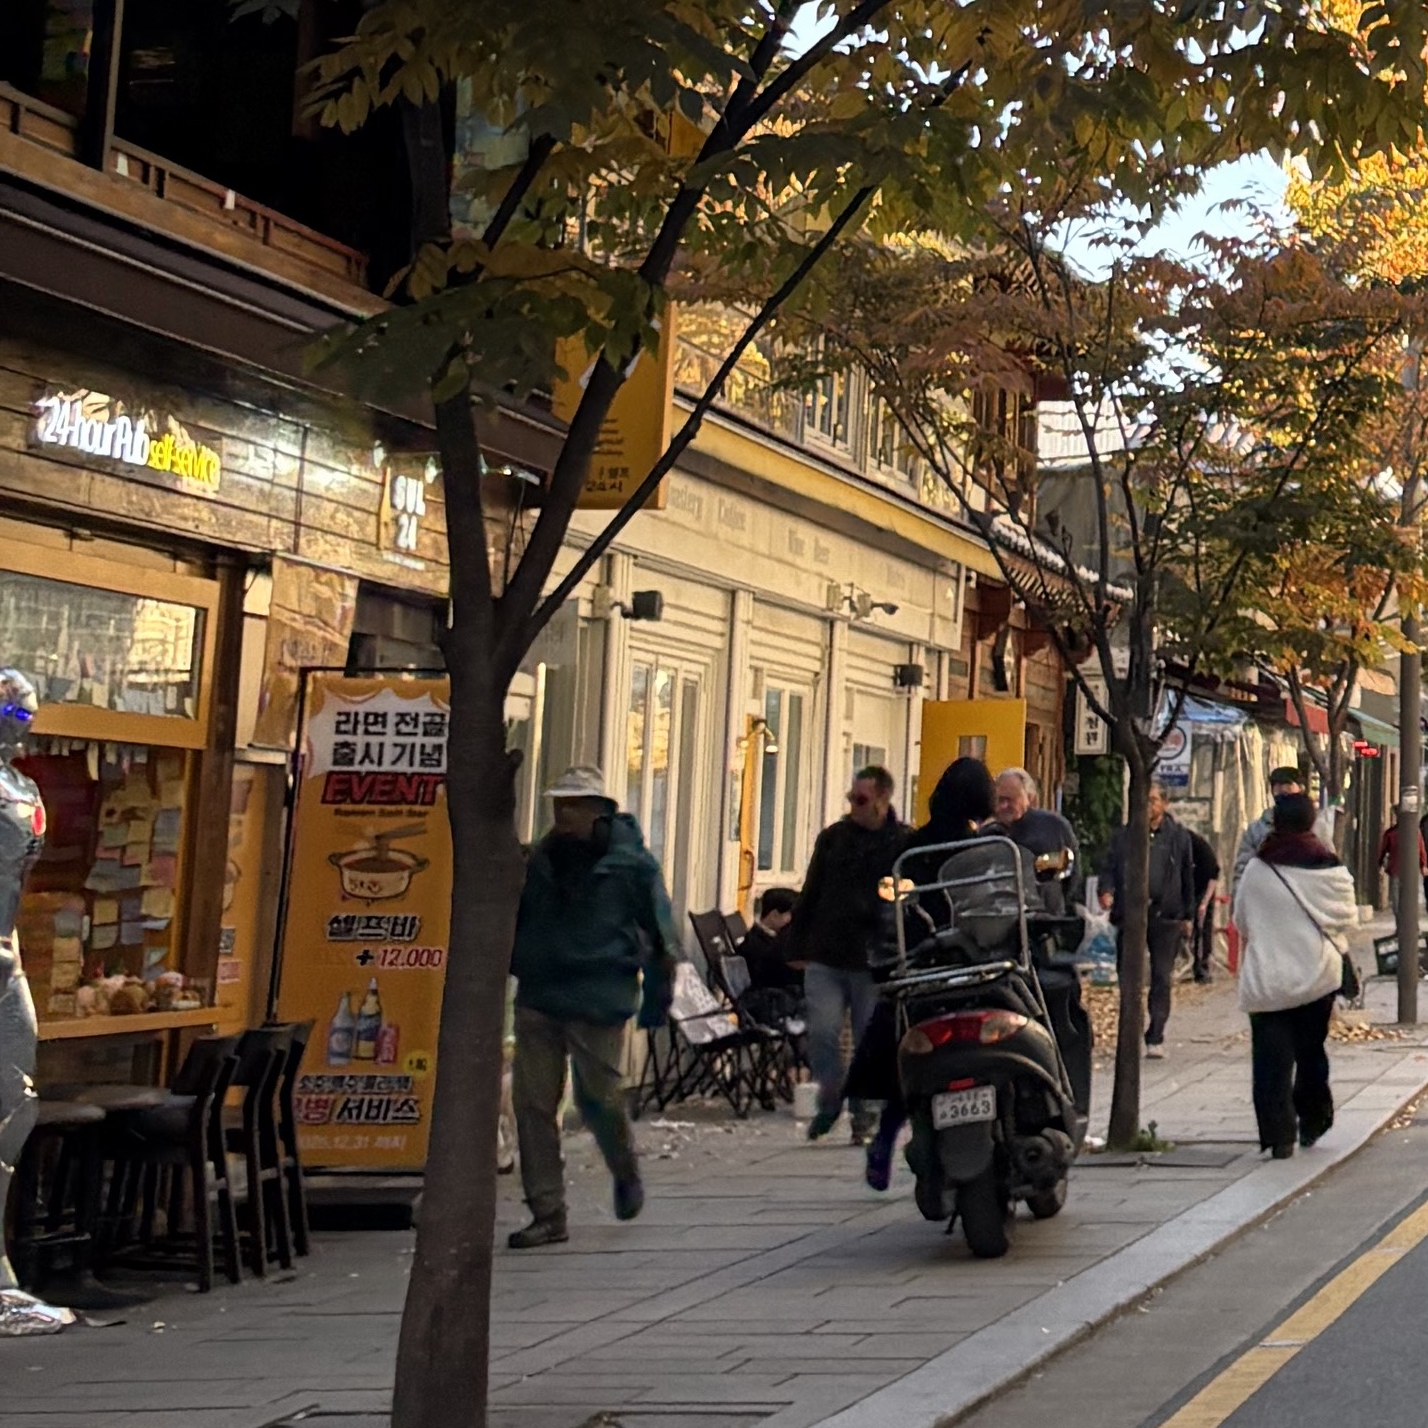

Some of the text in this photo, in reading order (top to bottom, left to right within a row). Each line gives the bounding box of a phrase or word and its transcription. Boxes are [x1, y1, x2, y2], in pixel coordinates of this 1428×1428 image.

[334, 711, 447, 738] 라면 전골
[332, 740, 444, 768] 출시 기념
[320, 769, 447, 806] EVENT
[328, 914, 420, 940] 셀프바
[335, 1096, 421, 1122] 서비스
